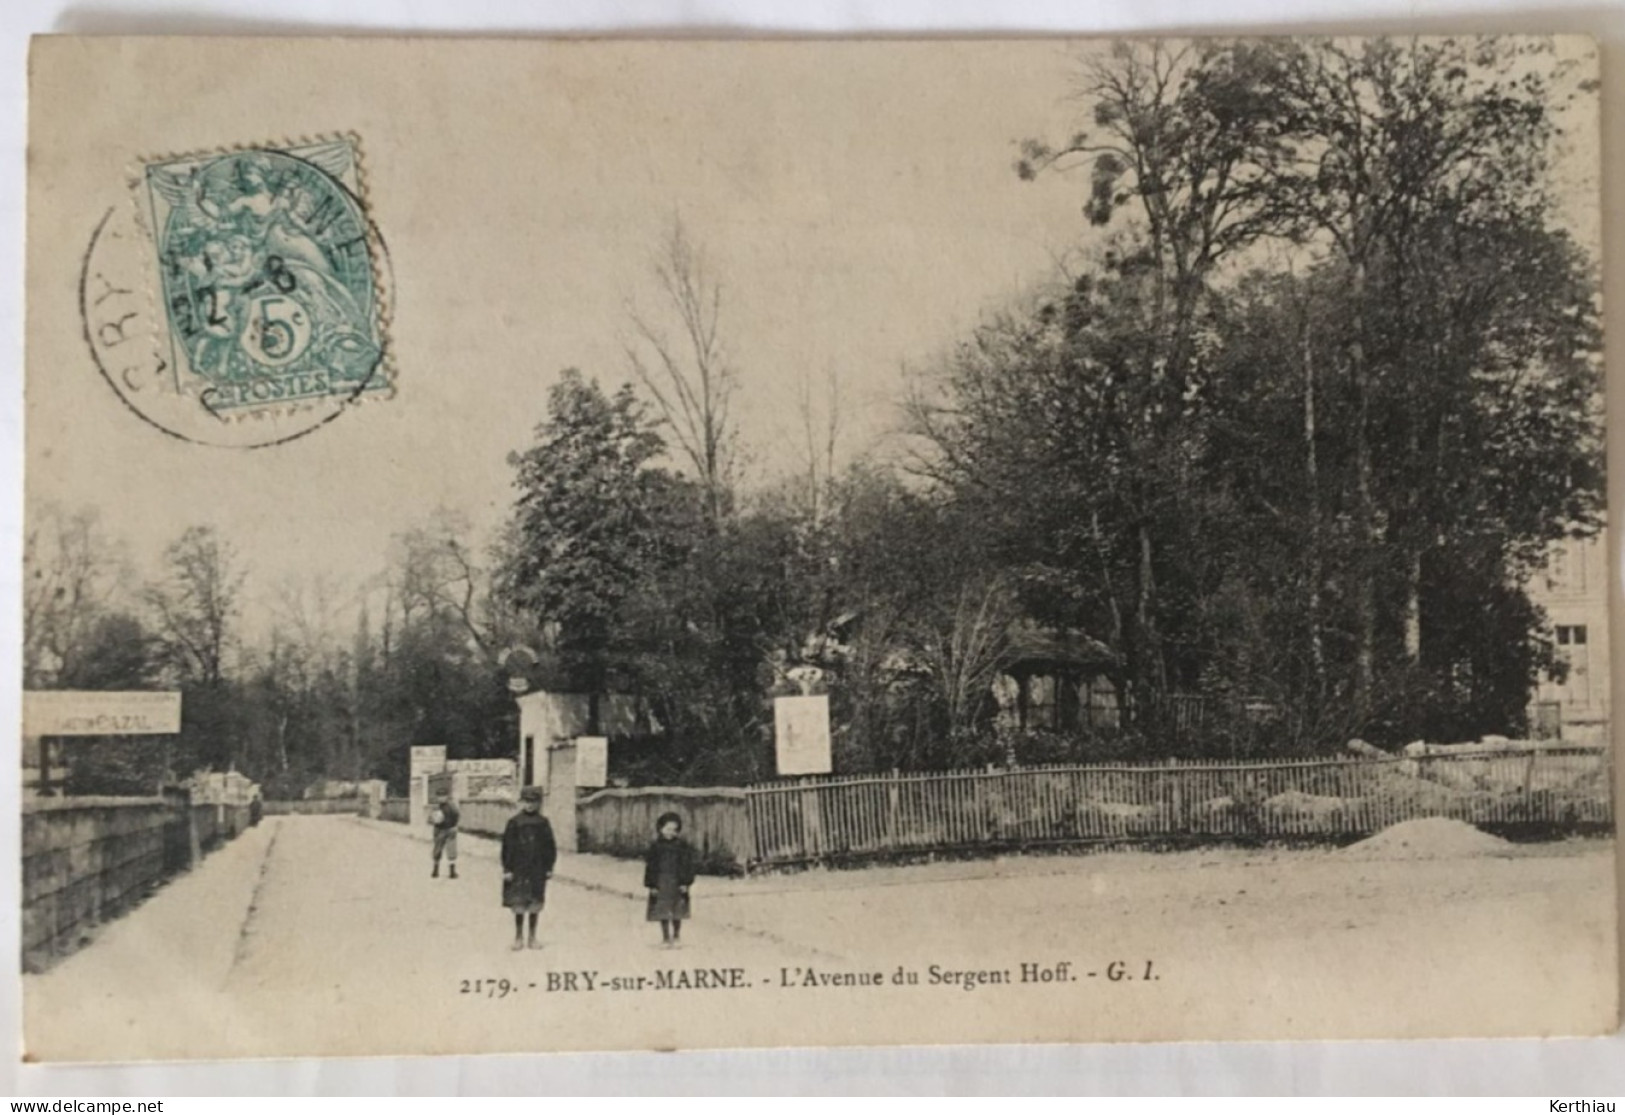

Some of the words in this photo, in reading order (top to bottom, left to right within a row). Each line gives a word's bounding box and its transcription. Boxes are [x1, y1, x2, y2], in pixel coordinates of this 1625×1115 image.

[238, 372, 328, 402] POSTES
[459, 978, 518, 998] 2179.
[546, 969, 754, 993] BRY-sur-MARNE.
[780, 966, 884, 988] L'Avenue
[892, 966, 918, 986] du
[929, 965, 1012, 991] Sergent
[1019, 962, 1077, 984] Hoff.
[1107, 960, 1133, 982] G.
